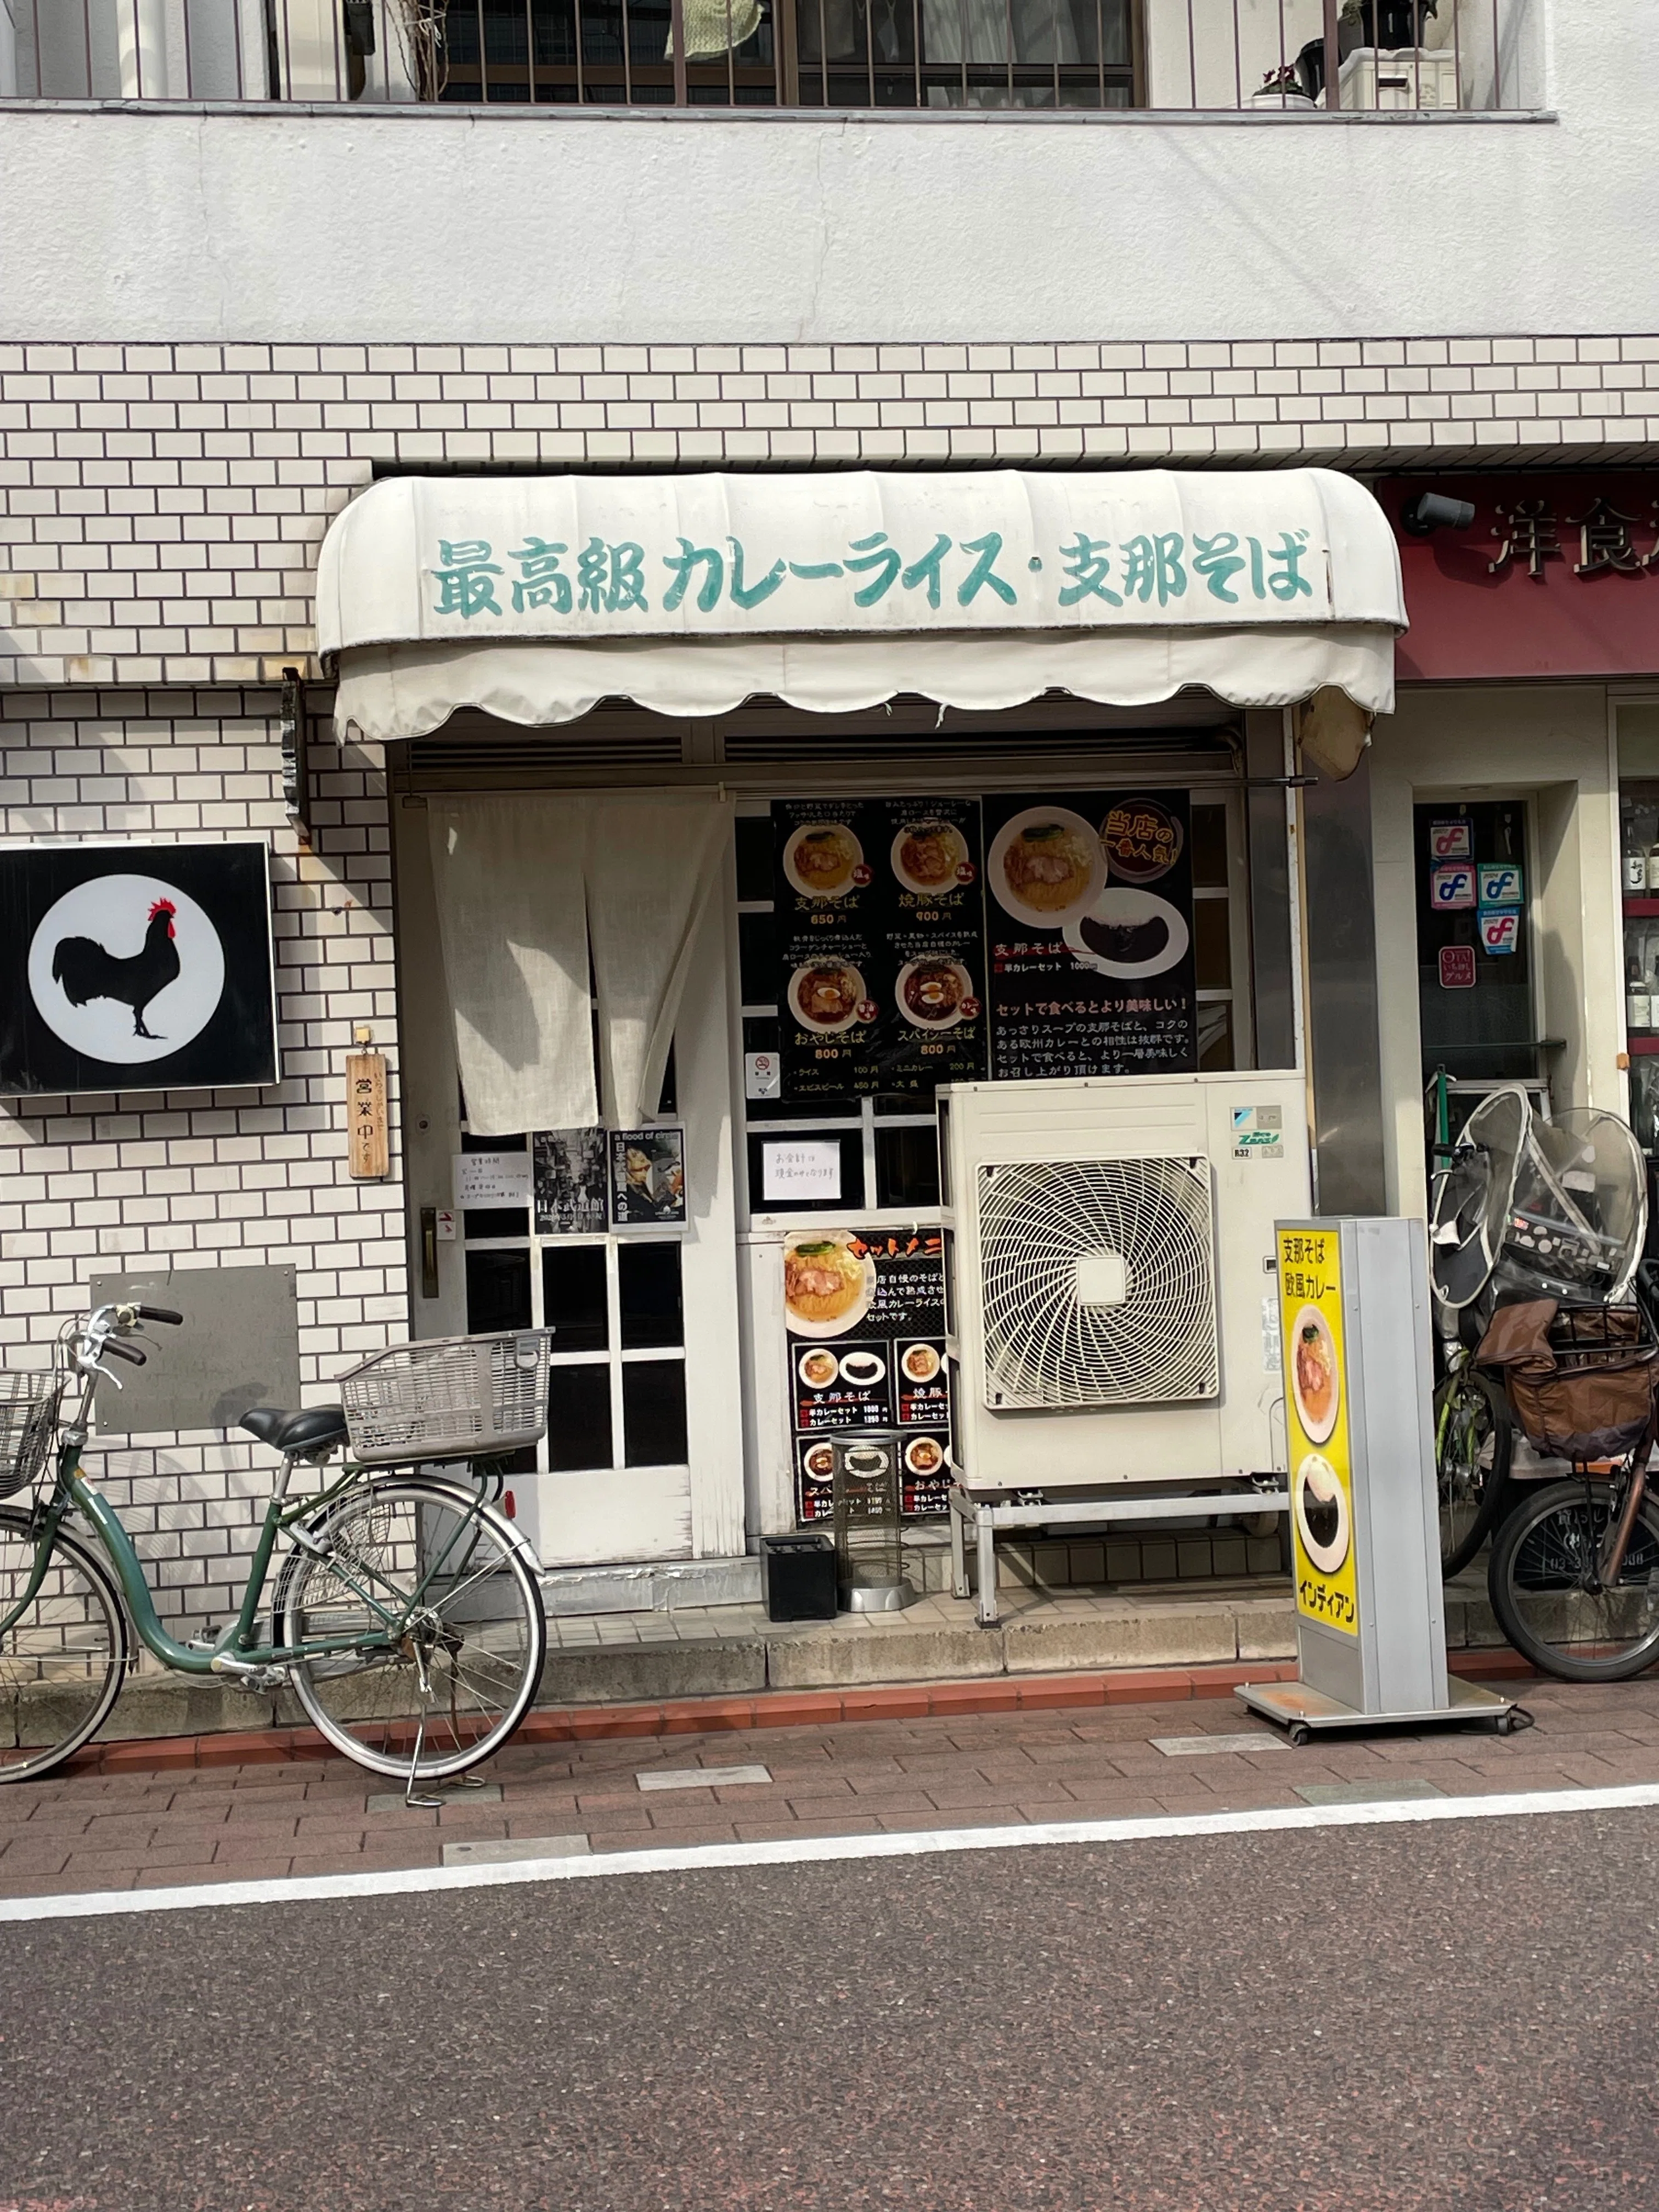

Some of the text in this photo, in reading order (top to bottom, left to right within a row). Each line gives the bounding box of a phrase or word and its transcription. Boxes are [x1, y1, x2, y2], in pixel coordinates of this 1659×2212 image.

[1105, 810, 1174, 843] 当店の
[795, 895, 861, 910] 支那そば
[899, 892, 965, 909] 焼豚そば
[994, 942, 1063, 957] 支那そば
[996, 998, 1186, 1017] セットで食べるとより美味しい！
[795, 1029, 868, 1045] おやじそば
[897, 1027, 977, 1041] スパイシーそば
[356, 1078, 374, 1164] 営業中です
[776, 1153, 815, 1165] お会計は
[1234, 1149, 1249, 1157] R32
[1283, 1237, 1325, 1264] 支那そば
[867, 1273, 944, 1284] 店自慢のそばと
[1285, 1272, 1336, 1300] 欧風カレー
[813, 1390, 872, 1404] 支那そば
[913, 1387, 947, 1399] 焼豚
[915, 1480, 961, 1491] おやじ
[1300, 1579, 1355, 1623] インディアン
